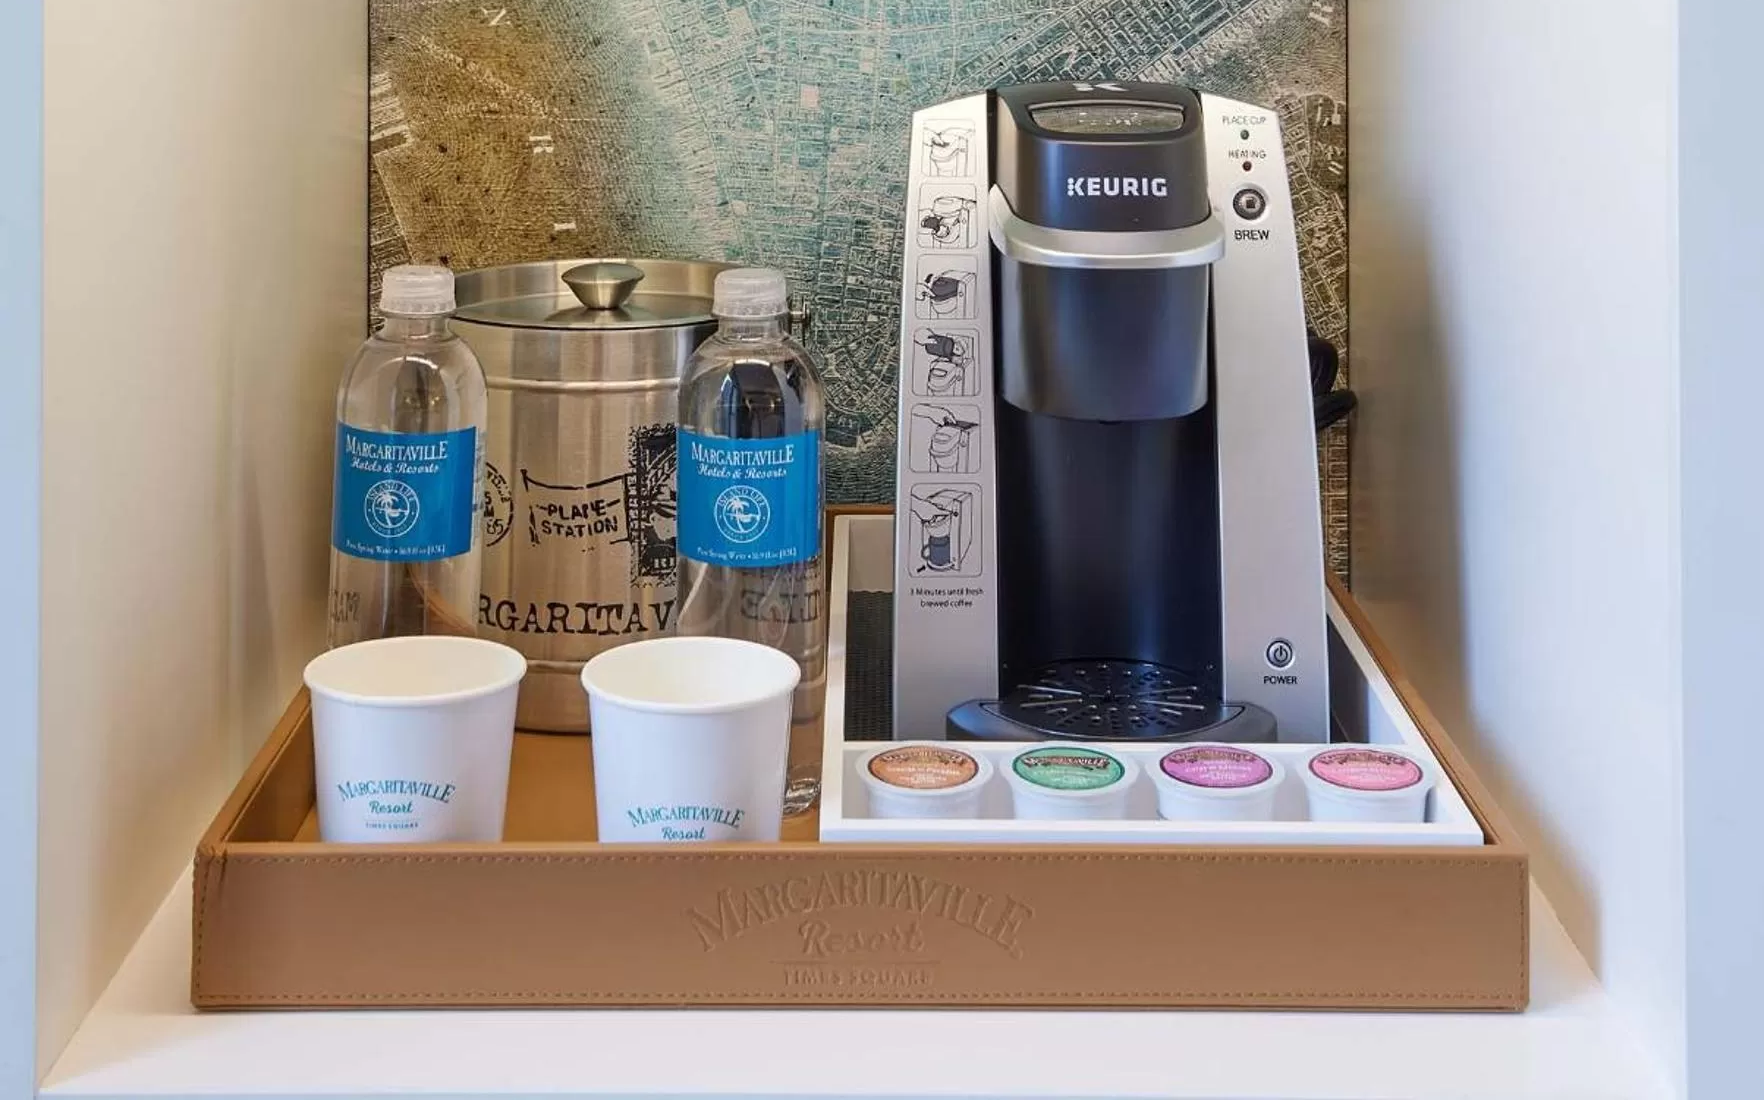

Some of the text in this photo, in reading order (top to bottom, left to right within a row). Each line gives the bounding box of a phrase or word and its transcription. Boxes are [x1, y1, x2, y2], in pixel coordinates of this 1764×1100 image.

[1222, 115, 1248, 125] PLACE
[1228, 149, 1266, 159] HEATING
[1067, 177, 1168, 197] KEURIG
[1234, 229, 1269, 241] BREW
[346, 434, 448, 461] MARGARITAVILLE
[691, 442, 795, 466] MARGARITAVILLE
[351, 457, 382, 473] Hotels
[395, 462, 440, 474] Resorts
[697, 464, 731, 479] Hotels
[744, 467, 787, 479] Resorts
[541, 516, 618, 538] STATION
[1263, 675, 1298, 685] POWER
[336, 779, 456, 804] MARGARITAVILLE
[369, 800, 414, 815] Resort
[627, 806, 745, 830] MARGARITAVILLE
[661, 826, 706, 841] Resort
[685, 869, 1037, 961] MARGARITAVILLE
[798, 918, 927, 957] Resort
[784, 967, 937, 987] TIMES SQUARE
